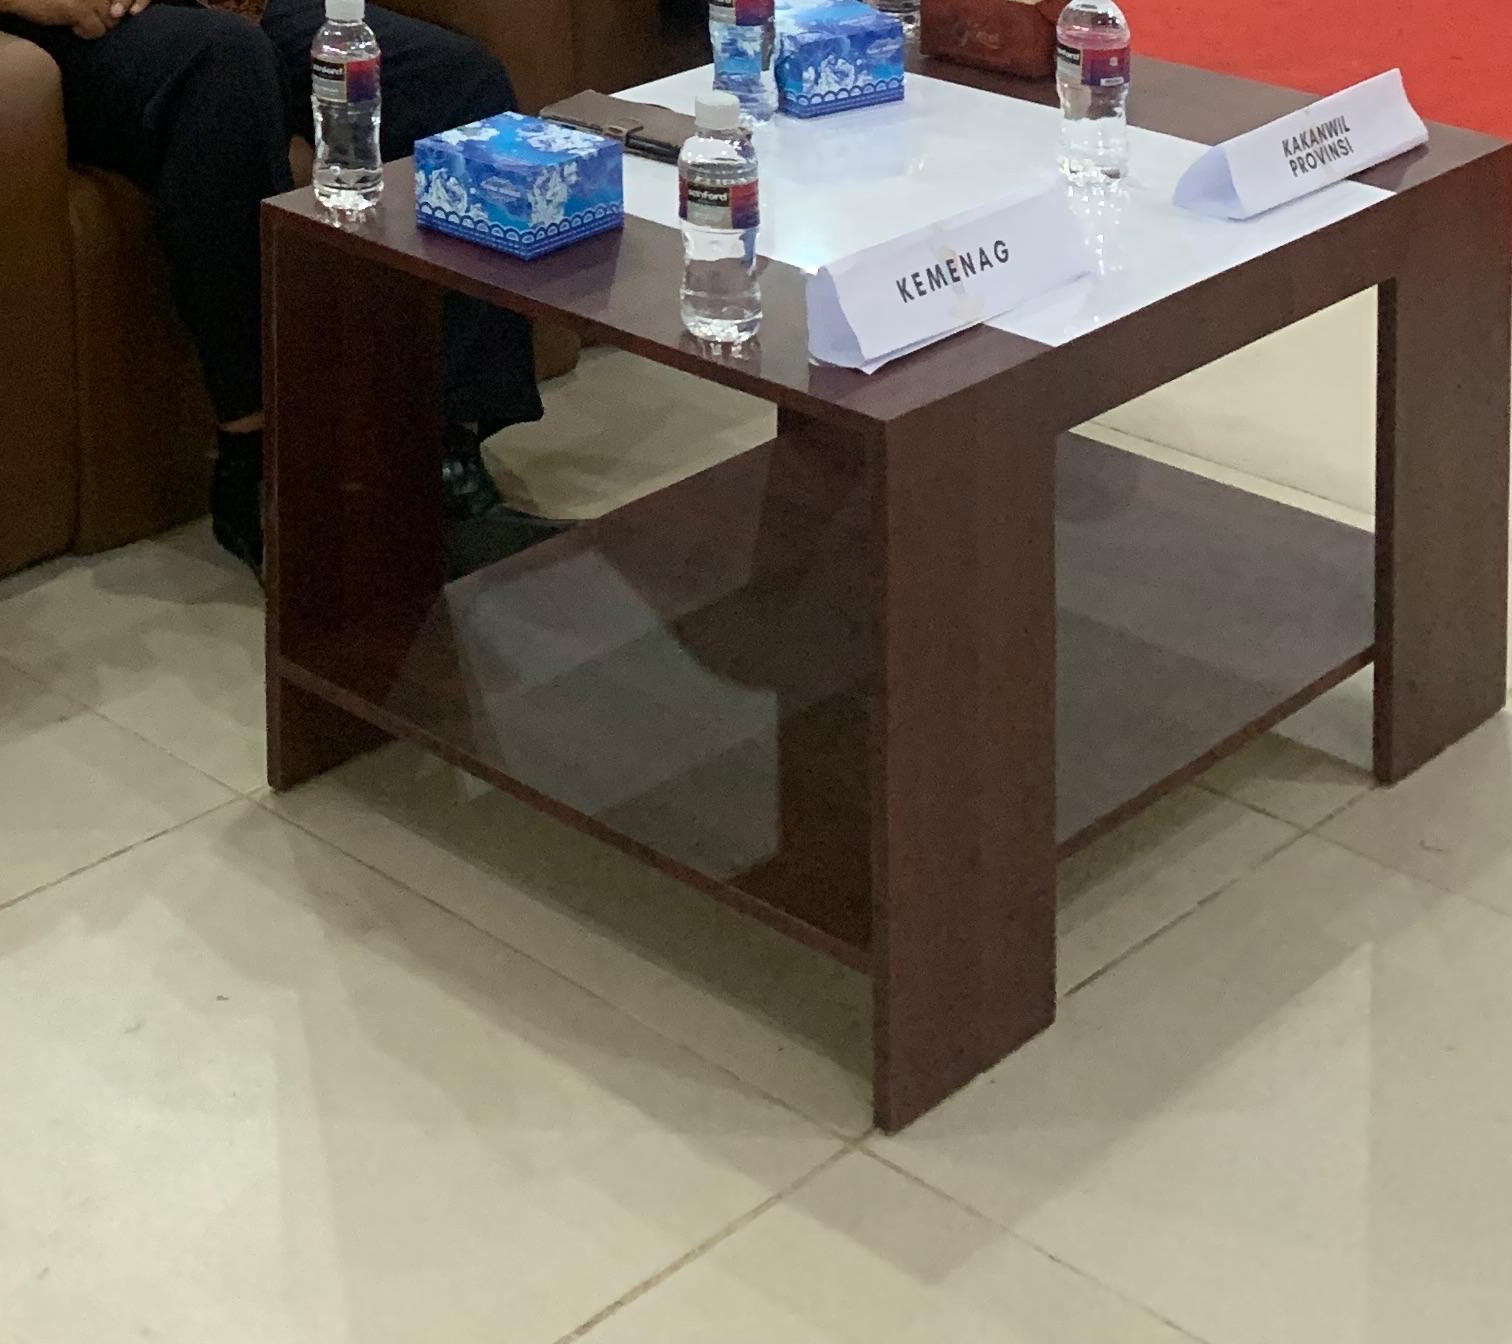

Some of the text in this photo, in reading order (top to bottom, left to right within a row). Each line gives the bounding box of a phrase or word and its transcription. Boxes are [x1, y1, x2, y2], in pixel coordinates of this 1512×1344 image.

[1282, 115, 1350, 158] KAKANWIL
[1289, 136, 1354, 177] PROVINSI
[896, 239, 1009, 303] KEMENAG
